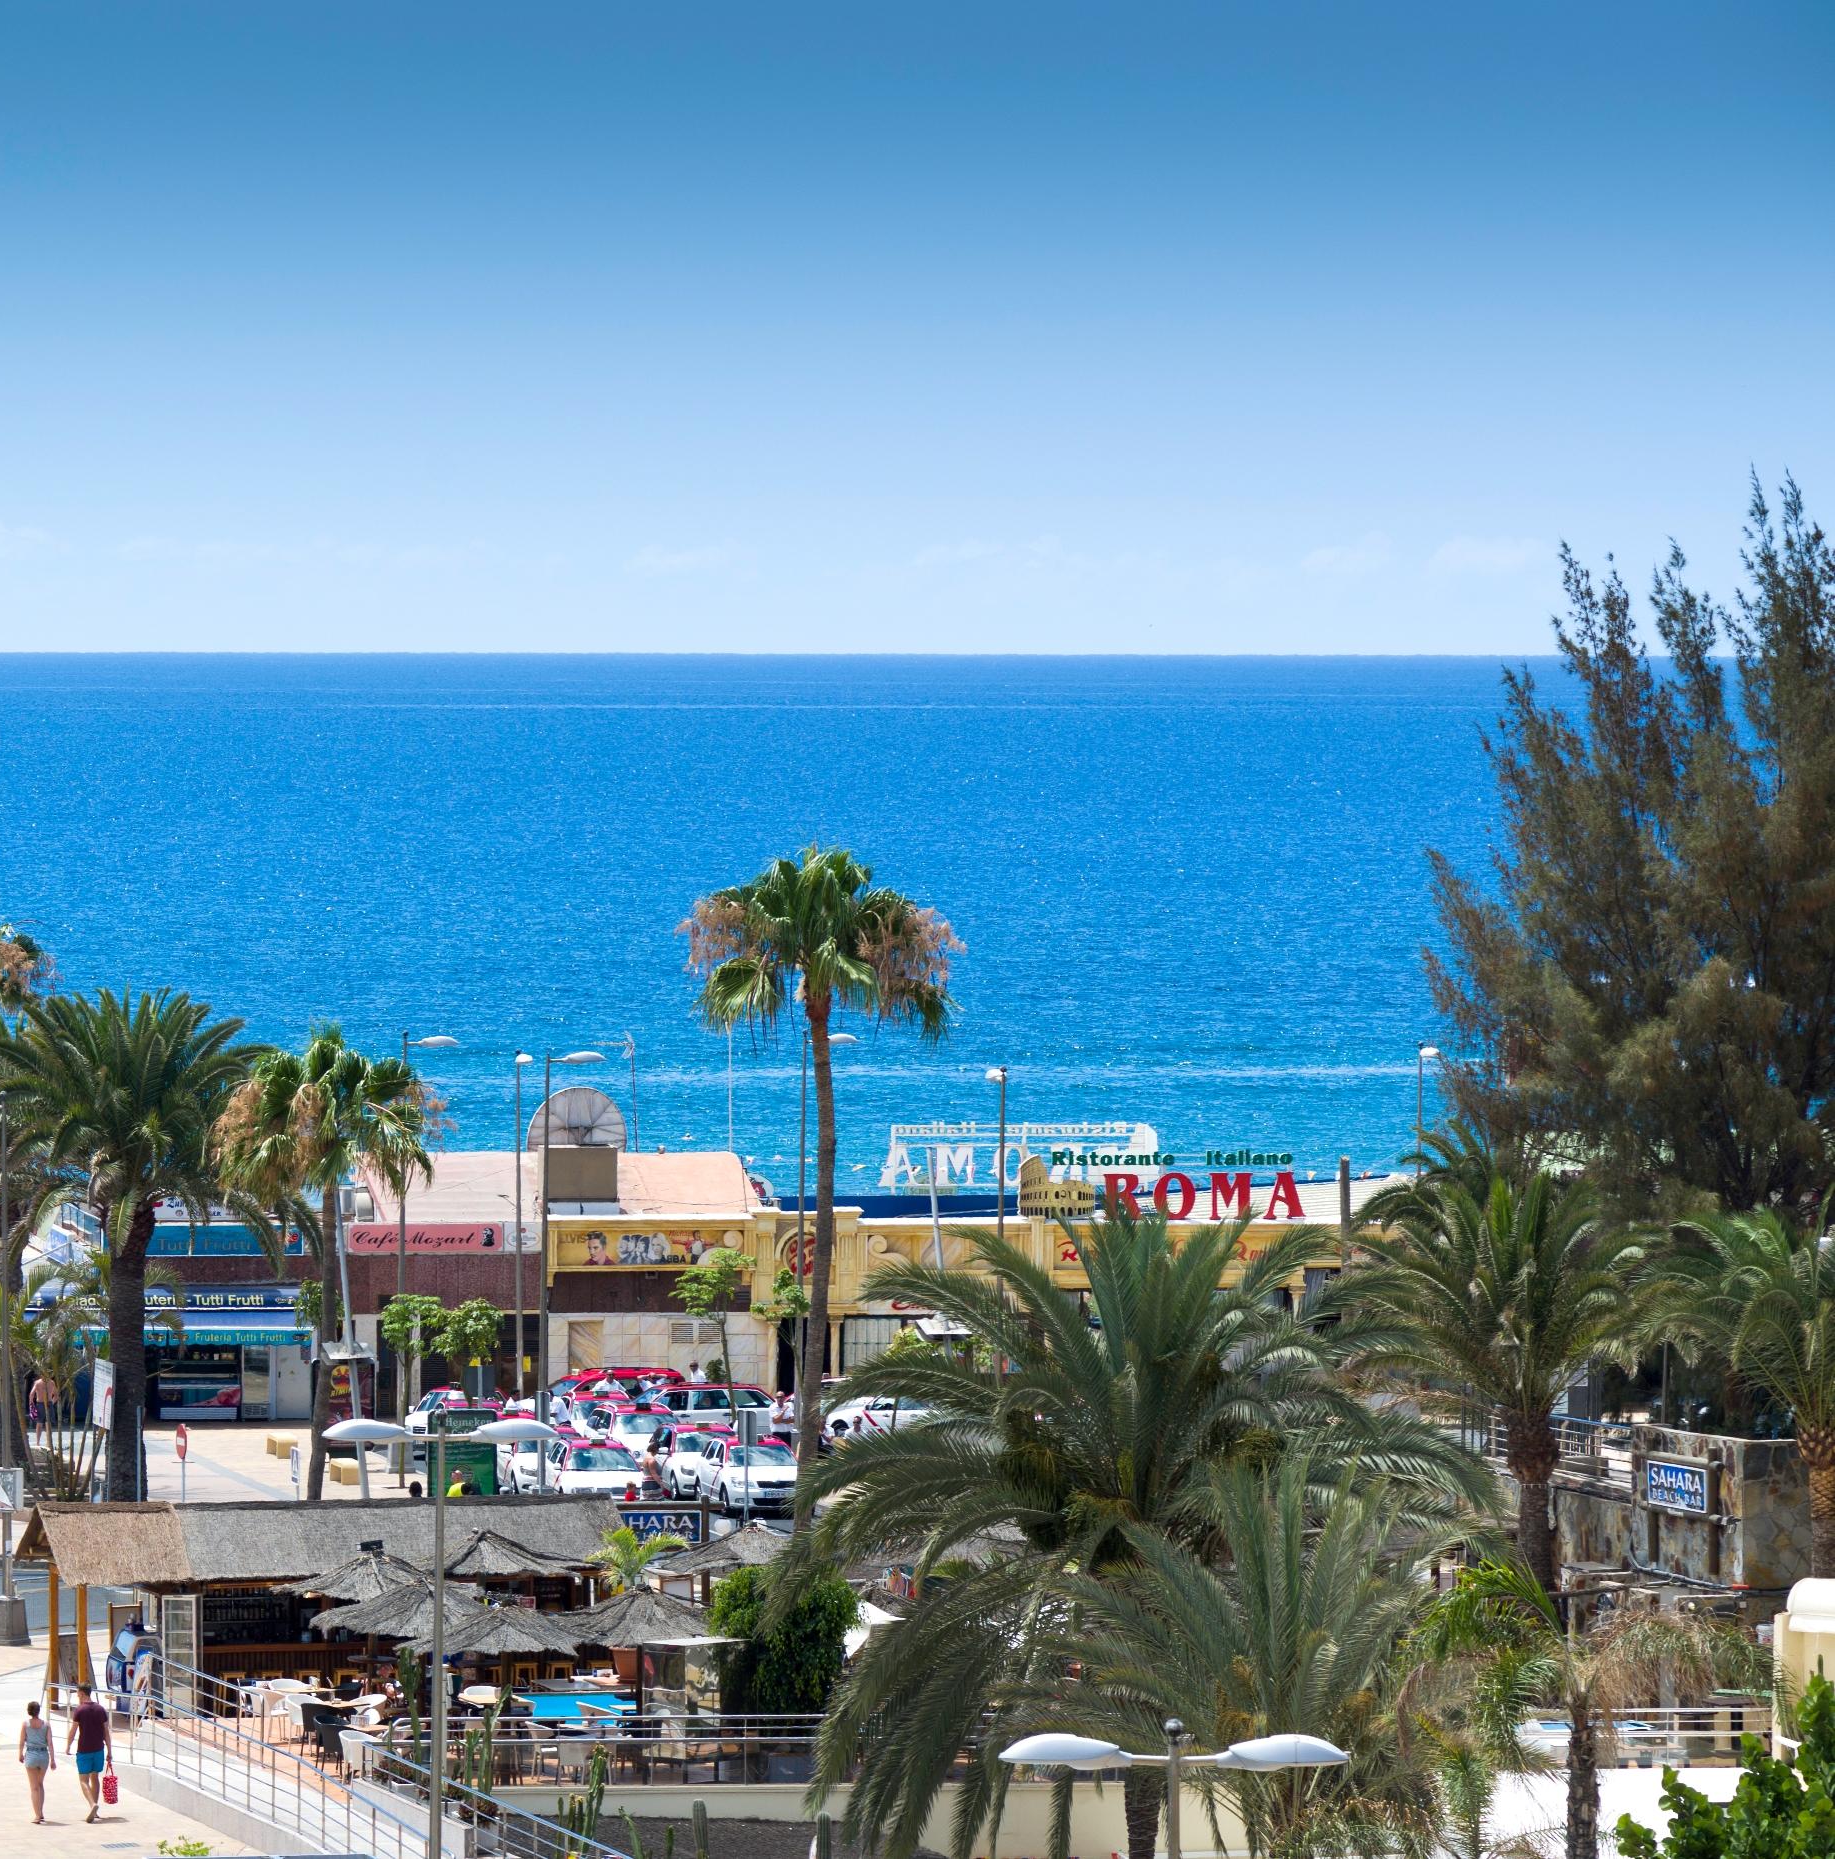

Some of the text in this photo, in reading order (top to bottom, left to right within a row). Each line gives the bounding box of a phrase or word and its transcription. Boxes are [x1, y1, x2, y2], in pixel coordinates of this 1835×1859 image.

[1051, 1150, 1293, 1166] Ristorante Italiano
[1103, 1171, 1307, 1221] ROMA
[352, 1231, 476, 1248] Café Mozart
[193, 1294, 223, 1306] Tutti
[228, 1294, 264, 1306] Frutti
[195, 1332, 232, 1342] Fruteria
[235, 1332, 257, 1342] Tutti
[260, 1332, 286, 1342] Frutti
[1651, 1467, 1702, 1494] SAHARA
[1652, 1487, 1702, 1507] BEACH BAR
[628, 1515, 695, 1530] HARA
